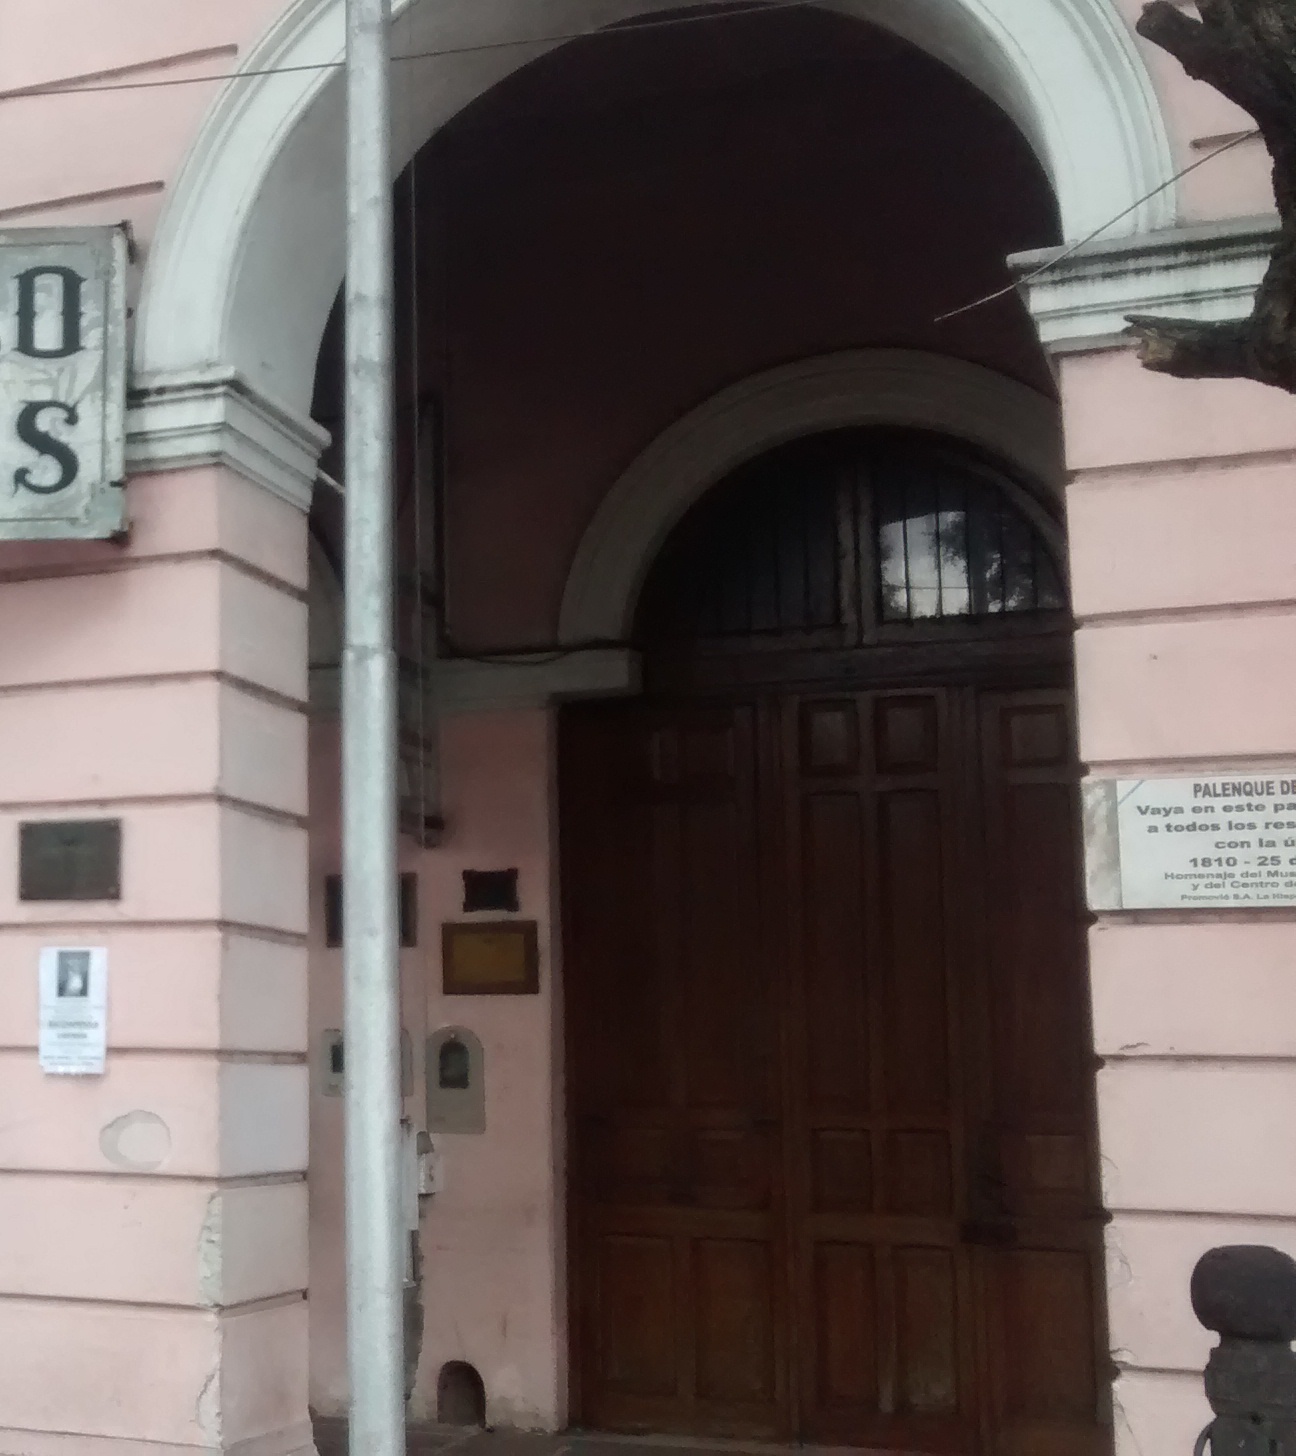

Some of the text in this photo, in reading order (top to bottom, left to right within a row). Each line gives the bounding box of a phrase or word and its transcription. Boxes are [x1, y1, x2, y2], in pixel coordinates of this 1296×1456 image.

[1193, 780, 1276, 798] PALENQUE
[1136, 804, 1185, 817] Vaya
[1191, 805, 1215, 814] en
[1222, 802, 1266, 813] este
[1147, 825, 1159, 833] a
[1165, 821, 1221, 833] todos
[1228, 820, 1257, 831] los
[1214, 840, 1251, 849] con
[1258, 837, 1276, 848] la
[1189, 856, 1238, 868] 1810
[1256, 855, 1281, 867] 25
[1164, 870, 1236, 880] Homenaje
[1240, 870, 1262, 878] del
[1191, 883, 1200, 891] y
[1204, 881, 1226, 889] del
[1230, 880, 1280, 889] Centro
